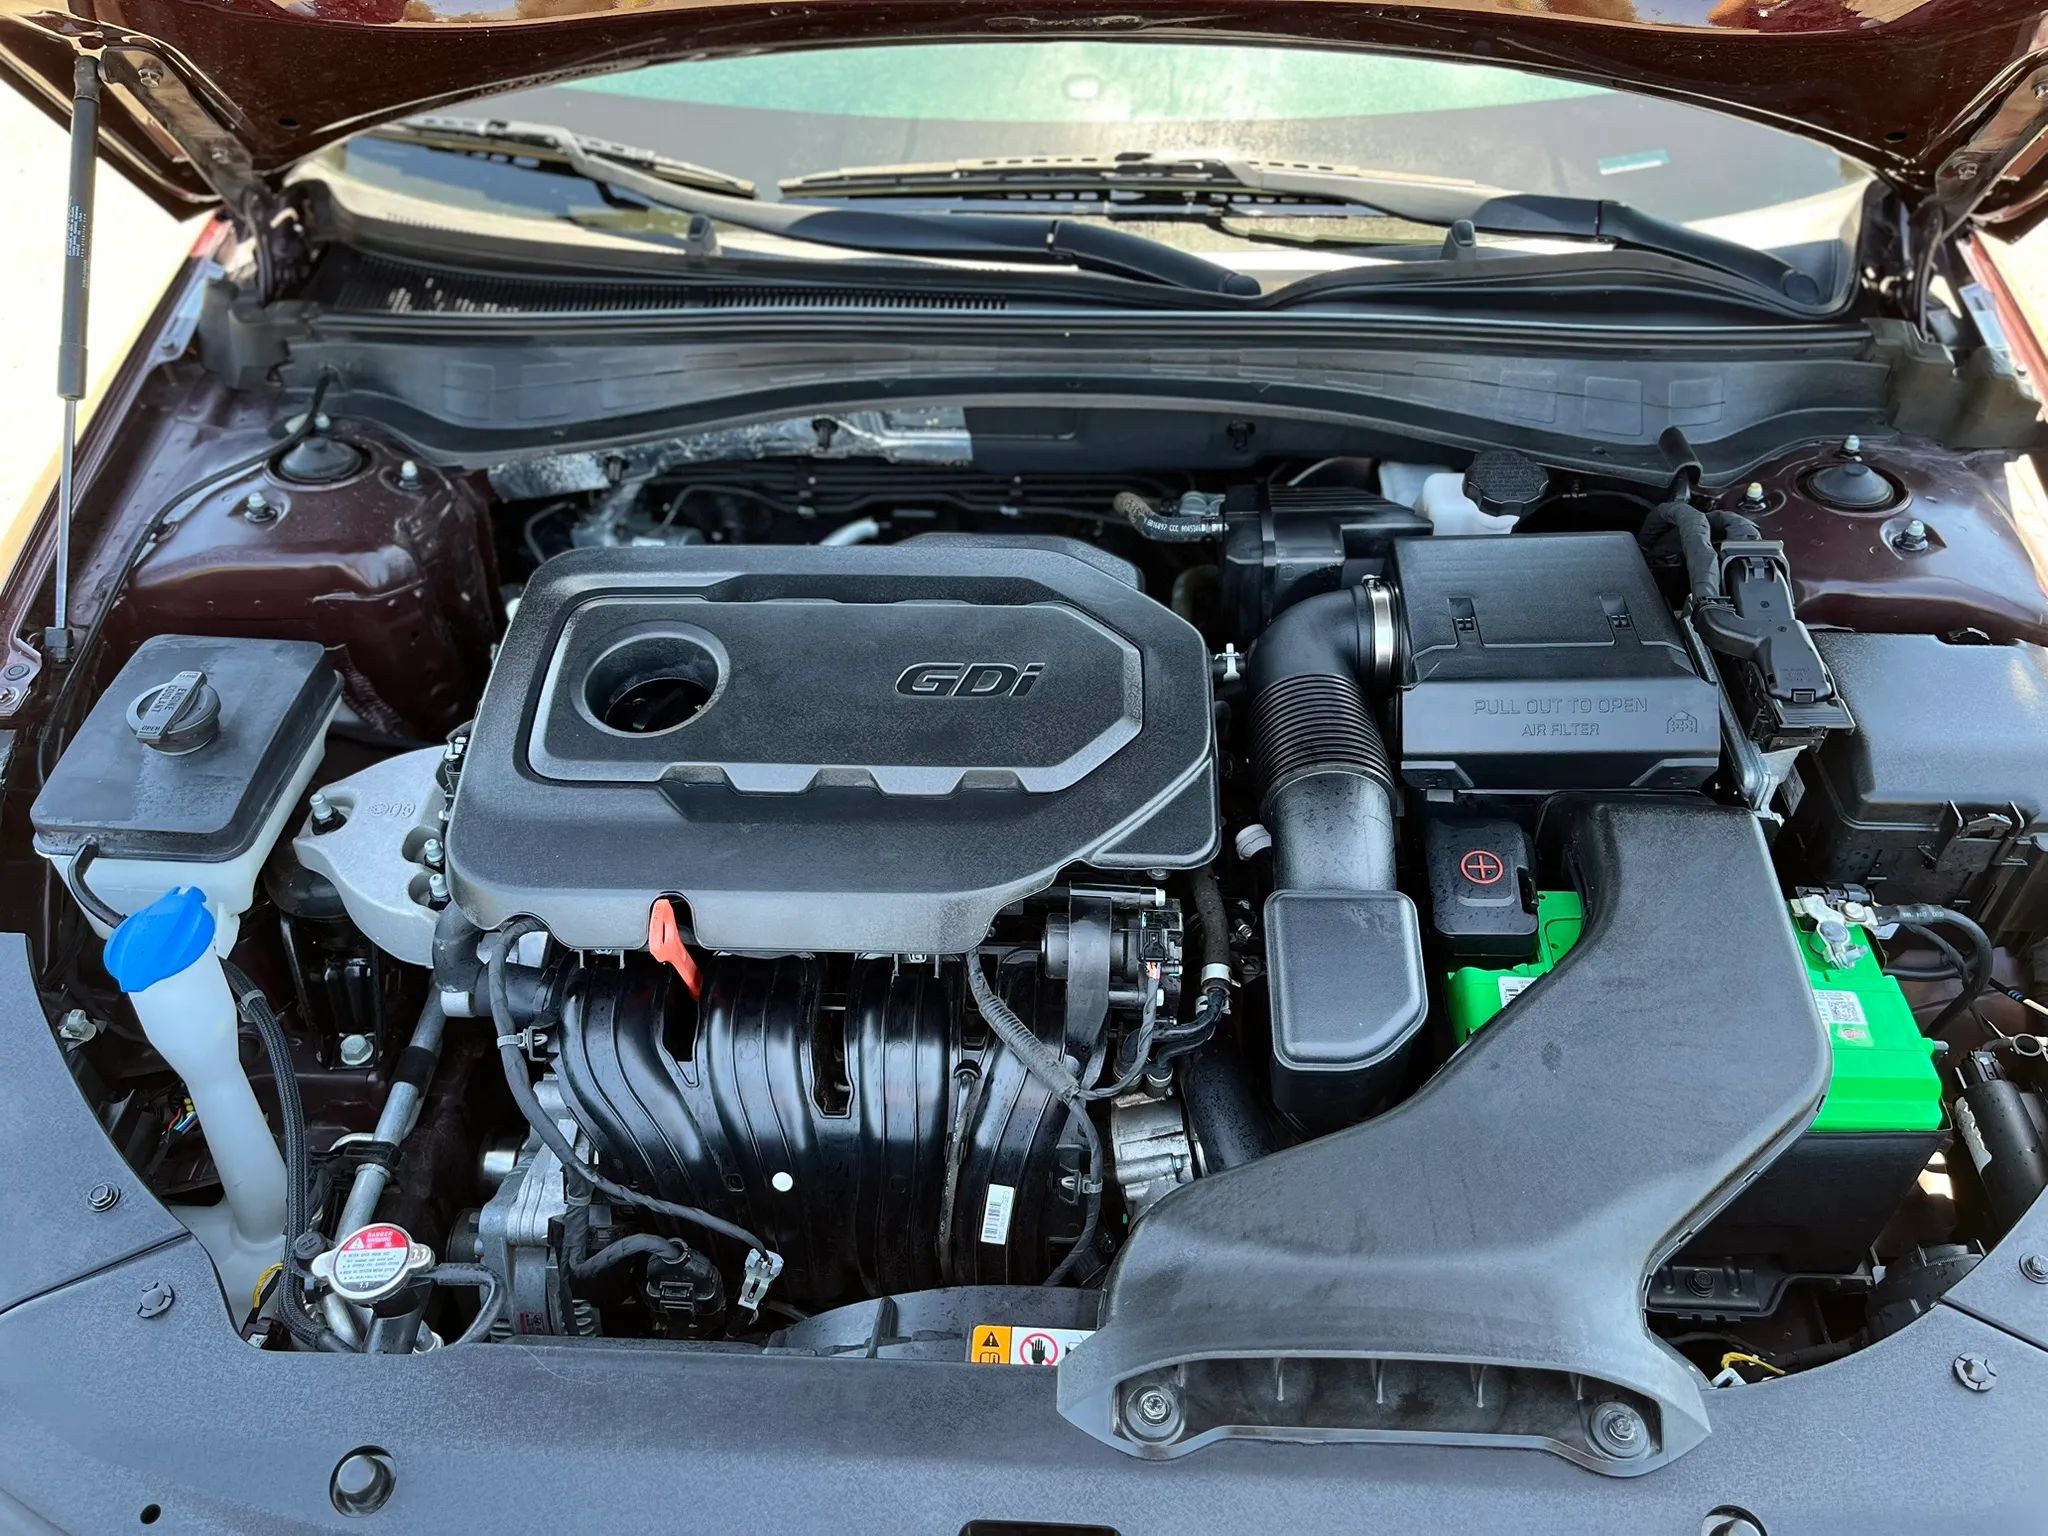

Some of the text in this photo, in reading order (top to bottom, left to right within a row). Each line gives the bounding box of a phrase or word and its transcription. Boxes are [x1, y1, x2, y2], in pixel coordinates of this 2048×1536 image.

[895, 662, 1045, 698] GDi
[1473, 697, 1648, 715] PULL OUT TO OPEN
[1521, 722, 1600, 736] AIR FILTER
